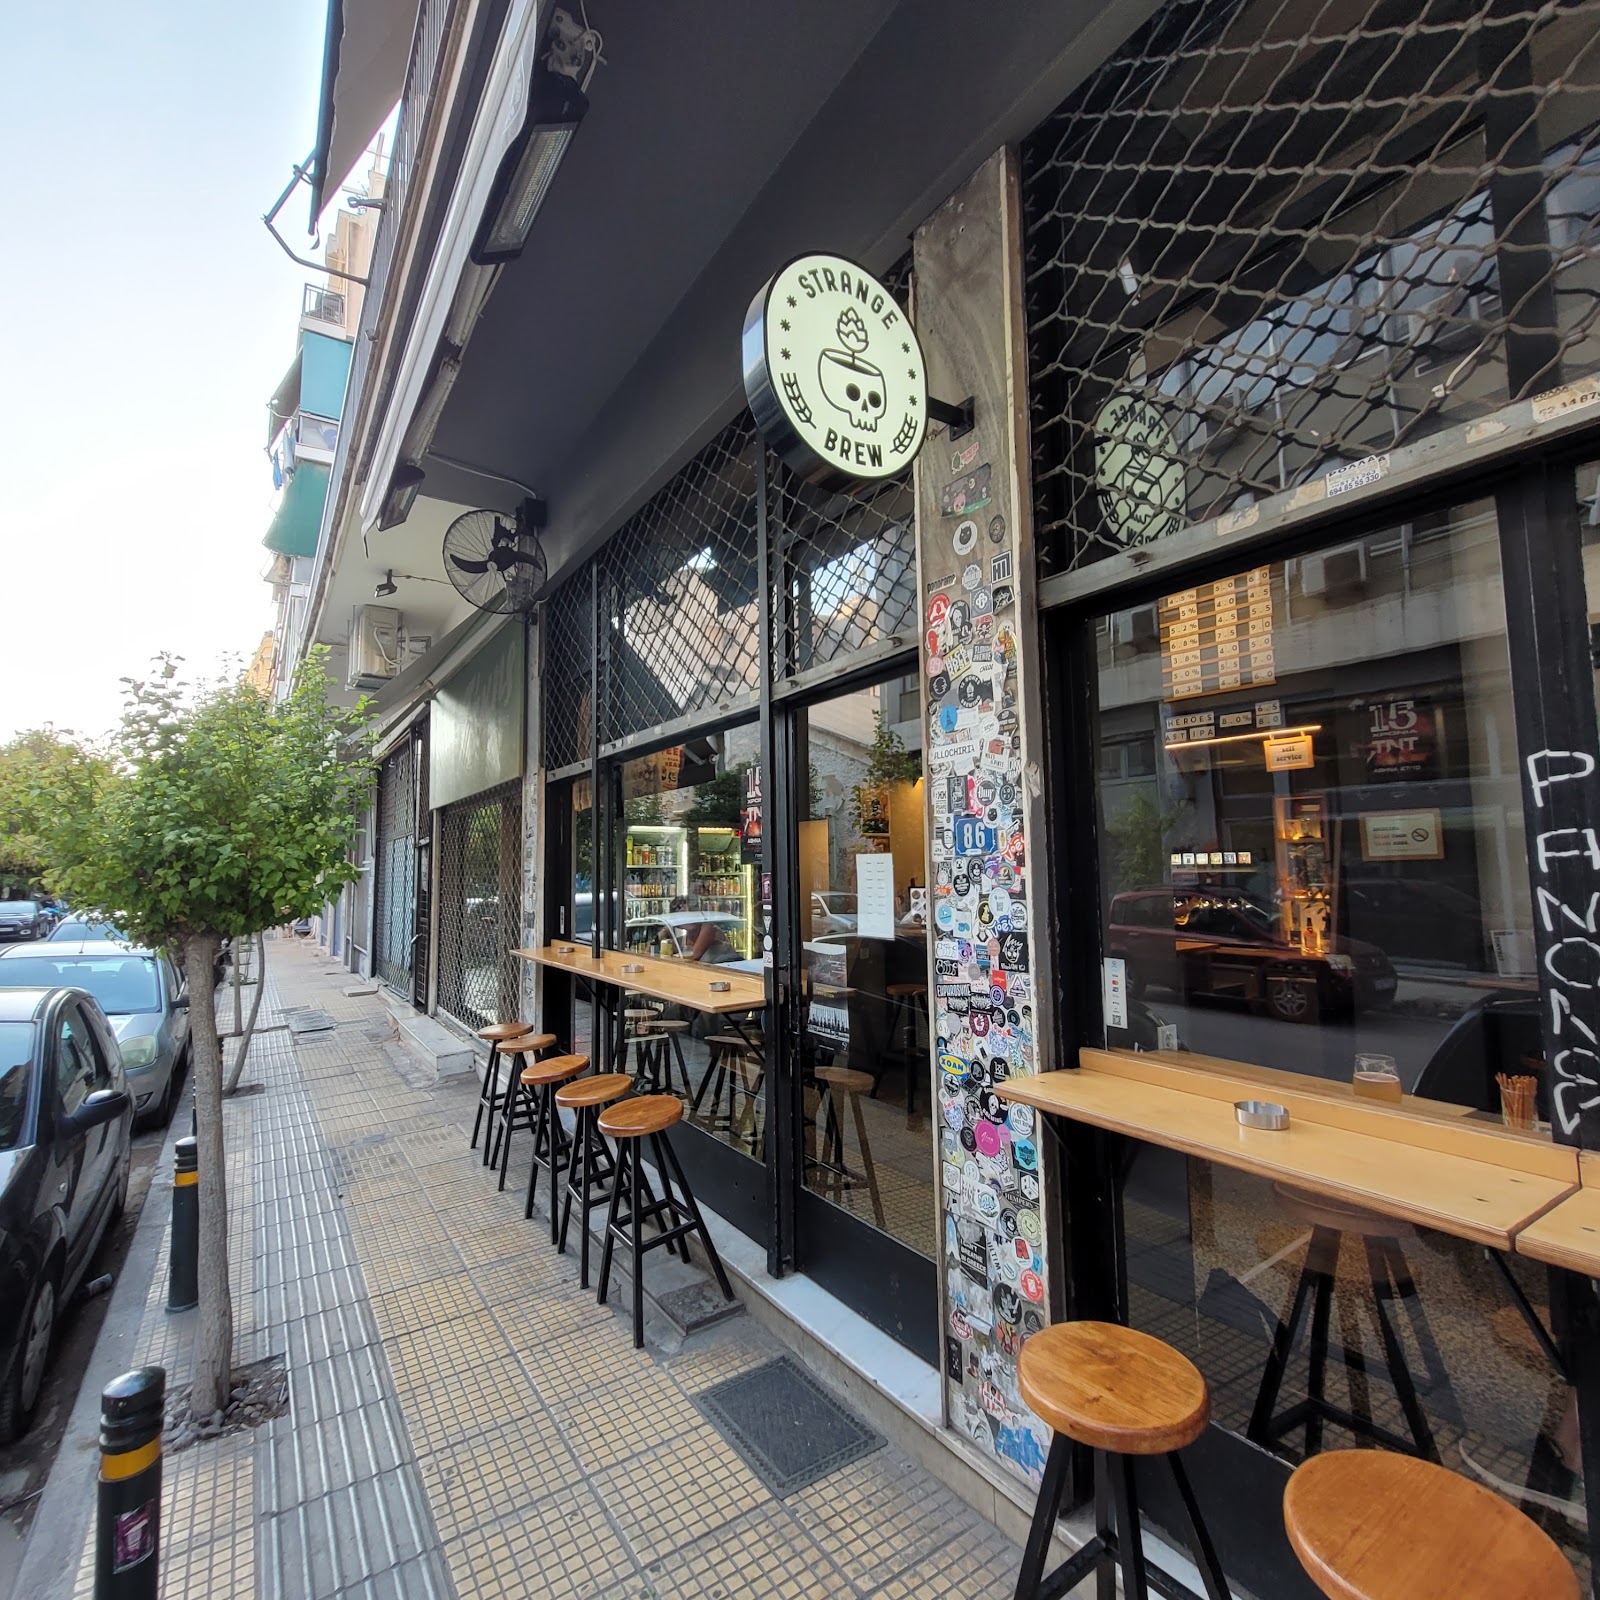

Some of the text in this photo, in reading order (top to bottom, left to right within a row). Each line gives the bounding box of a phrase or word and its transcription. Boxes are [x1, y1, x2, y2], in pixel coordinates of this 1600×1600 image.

[797, 267, 899, 330] STRANGE
[824, 427, 883, 468] BREW
[1329, 472, 1380, 496] 694 85 55 330
[1169, 593, 1195, 604] 4.5%
[1215, 582, 1233, 592] 5.0
[1181, 588, 1269, 617] 5% 4.0 4.5
[1171, 605, 1271, 635] 5.2% 4.5 5.5
[1171, 620, 1270, 650] 6.8% 7.5 9.0
[1173, 638, 1270, 665] 3.8% 4.0 5.0
[1174, 654, 1272, 679] 5.0% 5.5 7.0
[1175, 671, 1273, 694] 6.3% 4.5 6.0
[1257, 703, 1278, 712] 6.5
[1369, 701, 1418, 733] 15
[1168, 714, 1278, 727] HEROES 8.0% 8.0
[1192, 729, 1214, 738] IPA
[1276, 754, 1303, 762] service
[964, 822, 985, 848] 86
